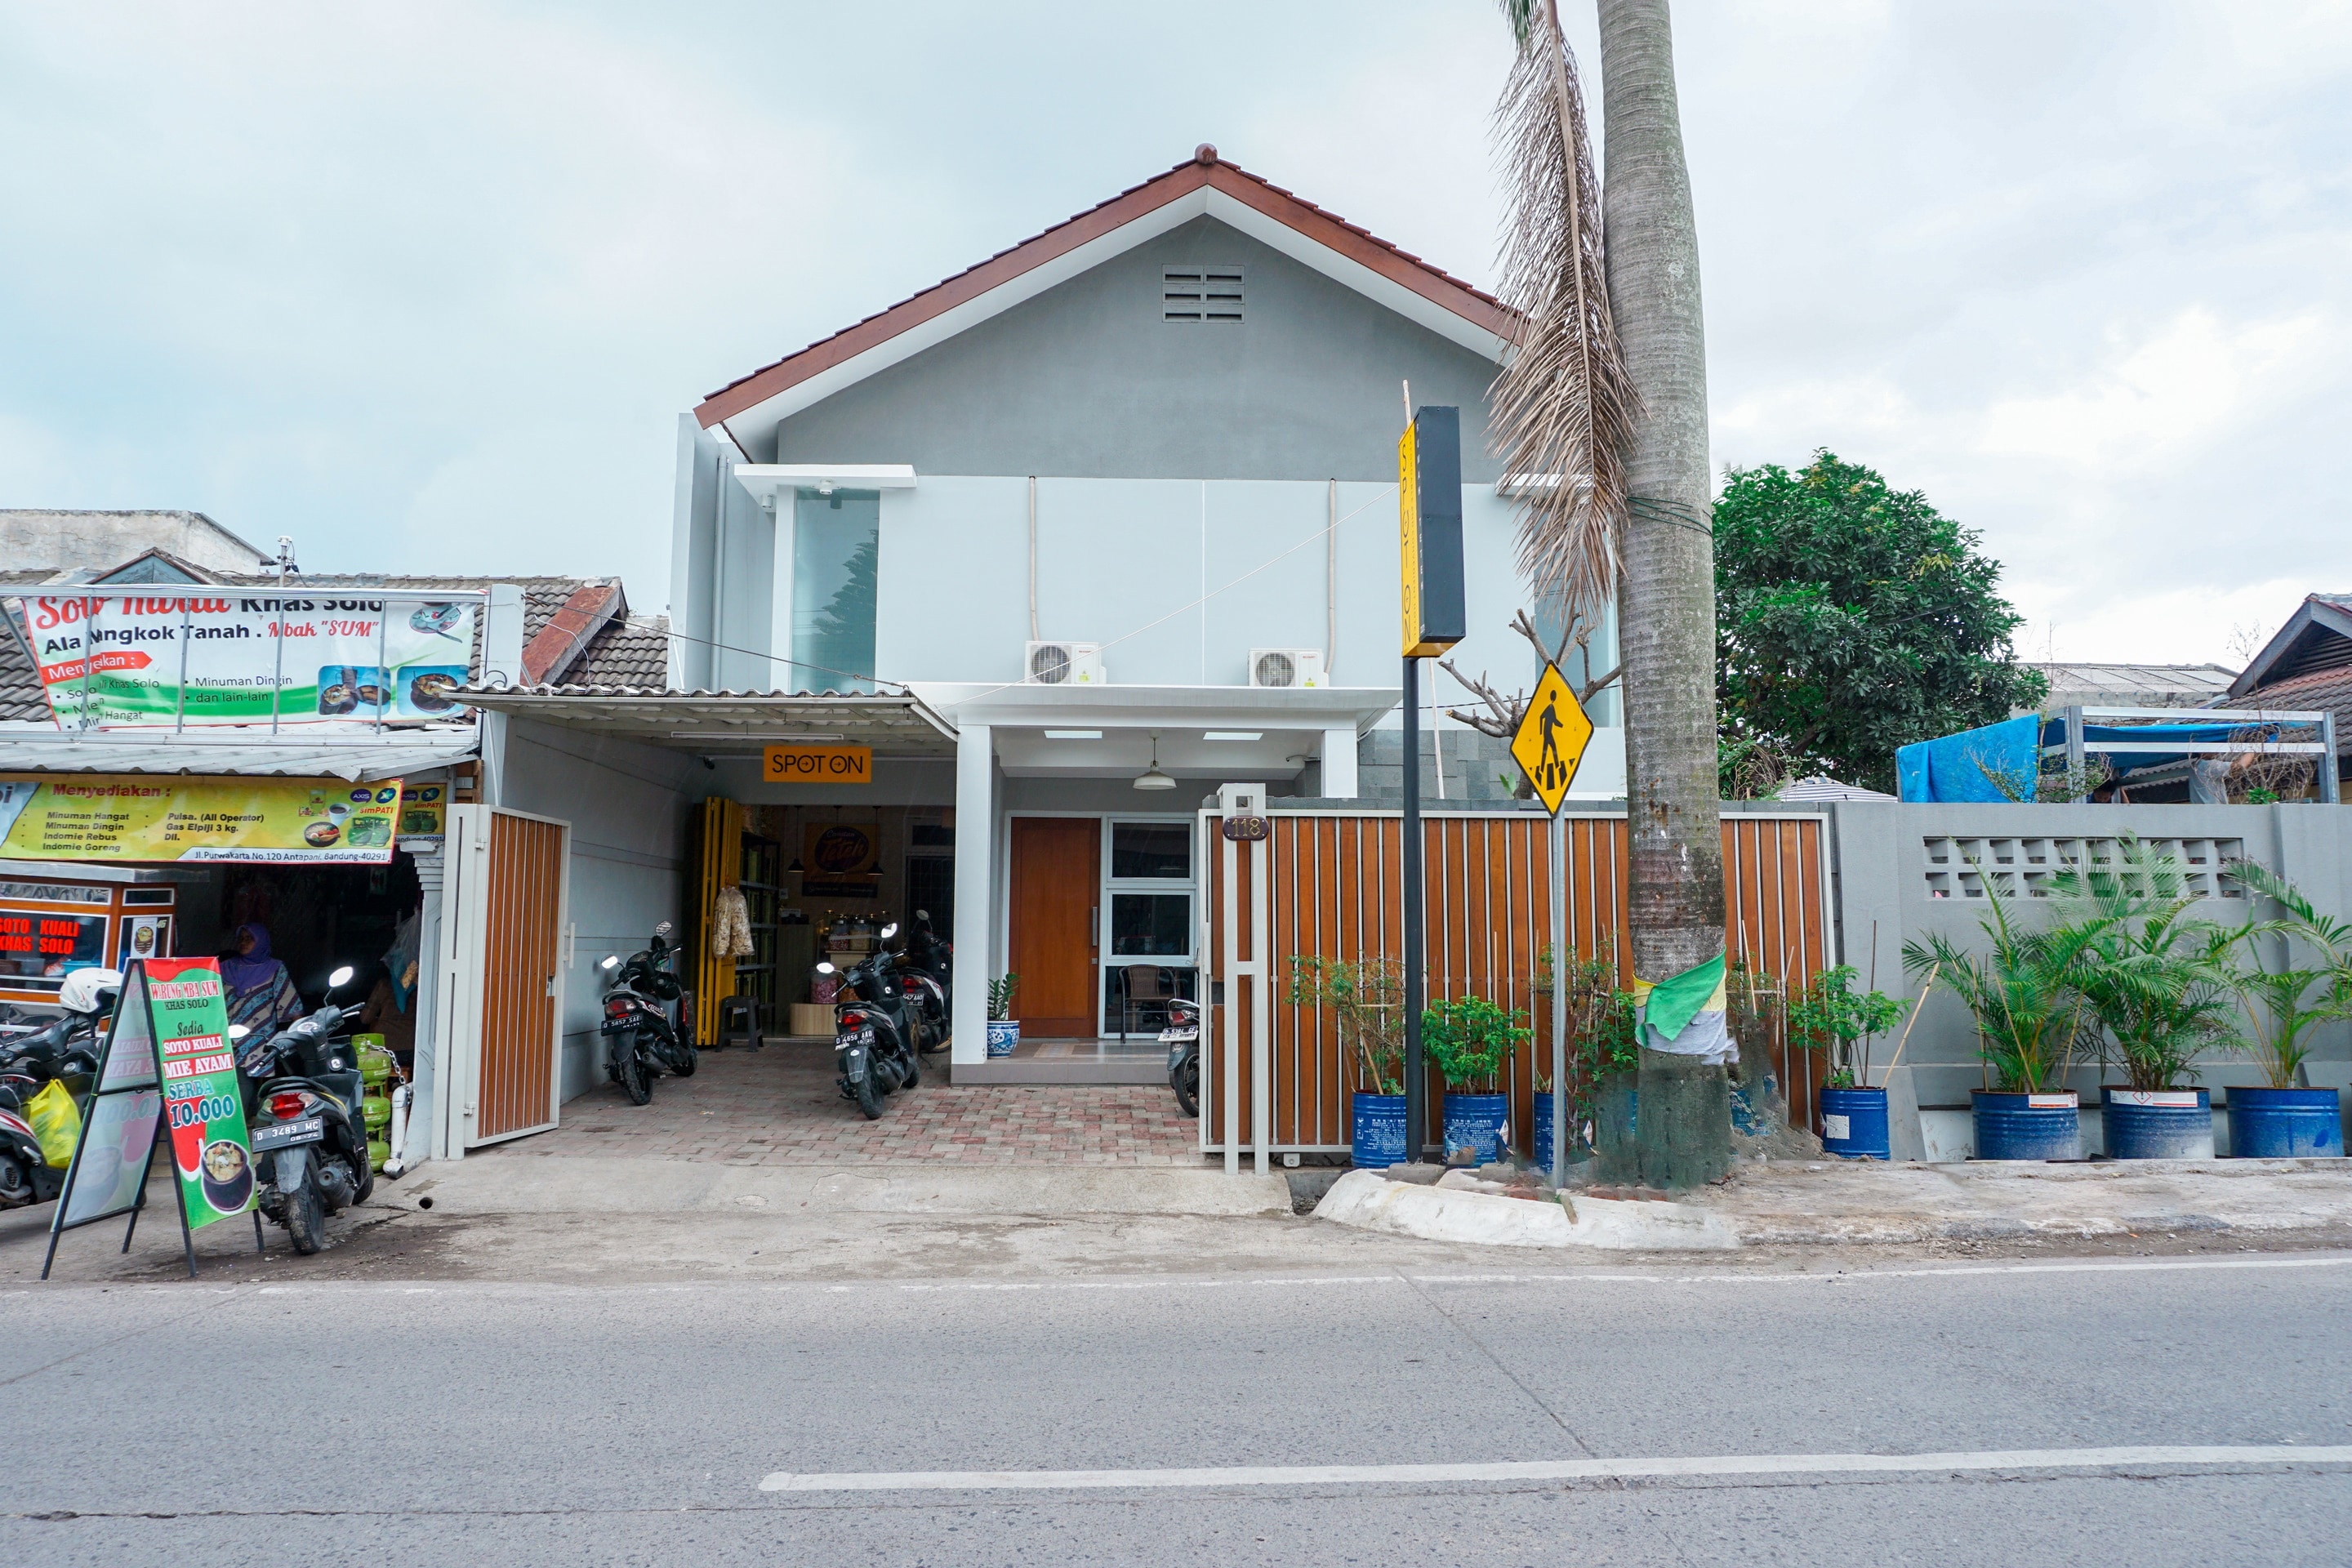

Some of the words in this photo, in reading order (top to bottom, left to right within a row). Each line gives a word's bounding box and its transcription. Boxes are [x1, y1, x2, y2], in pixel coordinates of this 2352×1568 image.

[44, 636, 82, 655] Ala
[180, 624, 249, 639] Tanah
[132, 678, 160, 688] Solo
[195, 677, 252, 687] Minuman
[196, 693, 220, 703] dan
[223, 691, 269, 702] lain-lain
[105, 710, 143, 722] Hangat
[772, 754, 826, 773] SPOT
[829, 755, 863, 774] ON
[52, 783, 161, 799] Menyediakan
[47, 812, 91, 820] Minuman
[94, 813, 130, 822] Hangat
[220, 814, 265, 822] Operator)
[46, 822, 90, 831] Minuman
[93, 822, 124, 831] Dingin
[1232, 817, 1261, 837] 118
[86, 833, 118, 841] Rebus
[42, 843, 82, 851] Indomie
[85, 844, 121, 853] Goreng
[39, 920, 80, 937] KUALI
[38, 938, 74, 955] SOLO
[149, 982, 181, 1000] WARUNG
[182, 982, 200, 998] MBA
[202, 980, 220, 996] SUM
[164, 1000, 185, 1010] KHAS
[187, 998, 209, 1009] SOLO
[176, 1020, 204, 1036] Sedia
[163, 1040, 190, 1054] SOTO
[193, 1036, 224, 1051] KUALI
[163, 1059, 193, 1079] MIE
[194, 1054, 234, 1075] AYAM
[168, 1079, 214, 1101] SERBA
[169, 1094, 235, 1129] 10.000
[256, 1132, 263, 1141] D
[272, 1125, 297, 1138] 3489
[305, 1121, 318, 1130] MC
